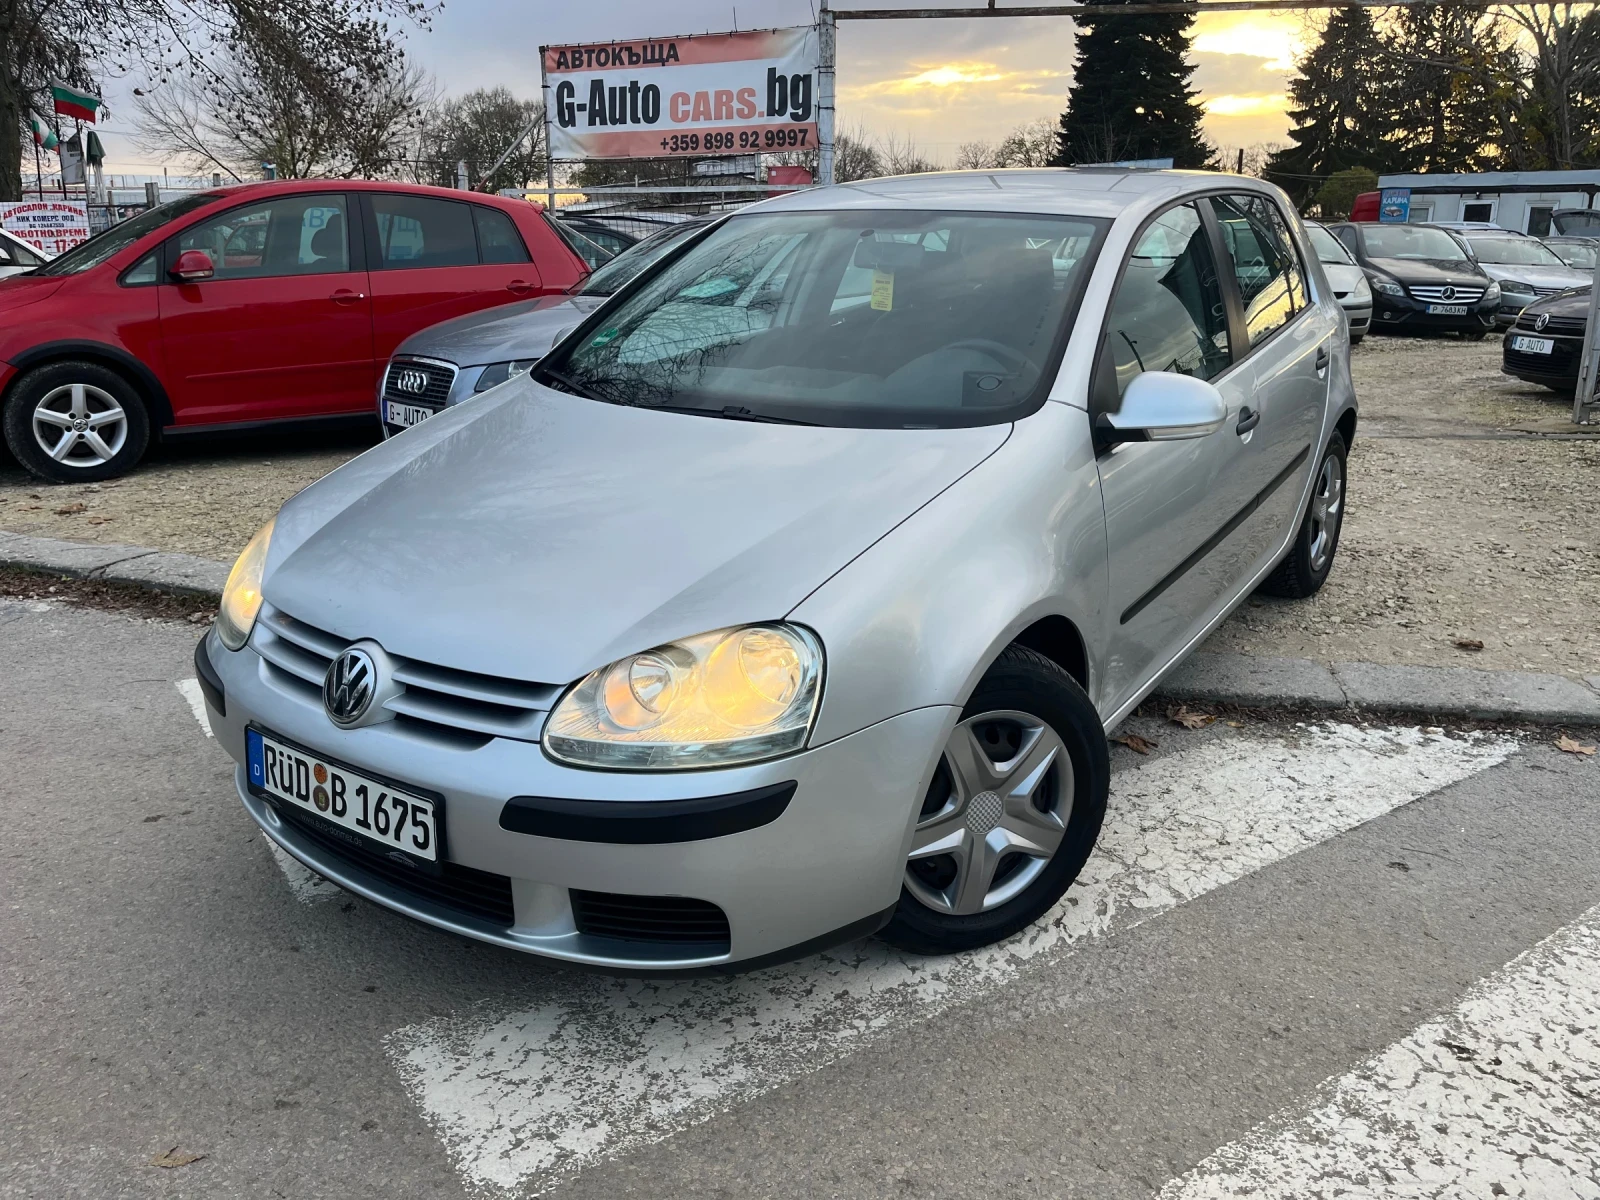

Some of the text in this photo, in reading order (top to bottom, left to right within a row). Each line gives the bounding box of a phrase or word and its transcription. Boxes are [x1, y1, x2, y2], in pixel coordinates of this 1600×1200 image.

[556, 43, 680, 69] АВТОКЪЩА
[556, 79, 661, 129] G-Auto
[660, 129, 808, 151] +359 898 92 9997
[3, 203, 48, 220] АВТОСАЛОН
[62, 214, 75, 222] ООД
[56, 228, 88, 237] ВРЕМЕ
[1526, 339, 1545, 352] AUTO
[254, 763, 260, 776] D
[331, 772, 348, 818] B
[355, 784, 430, 850] 1675
